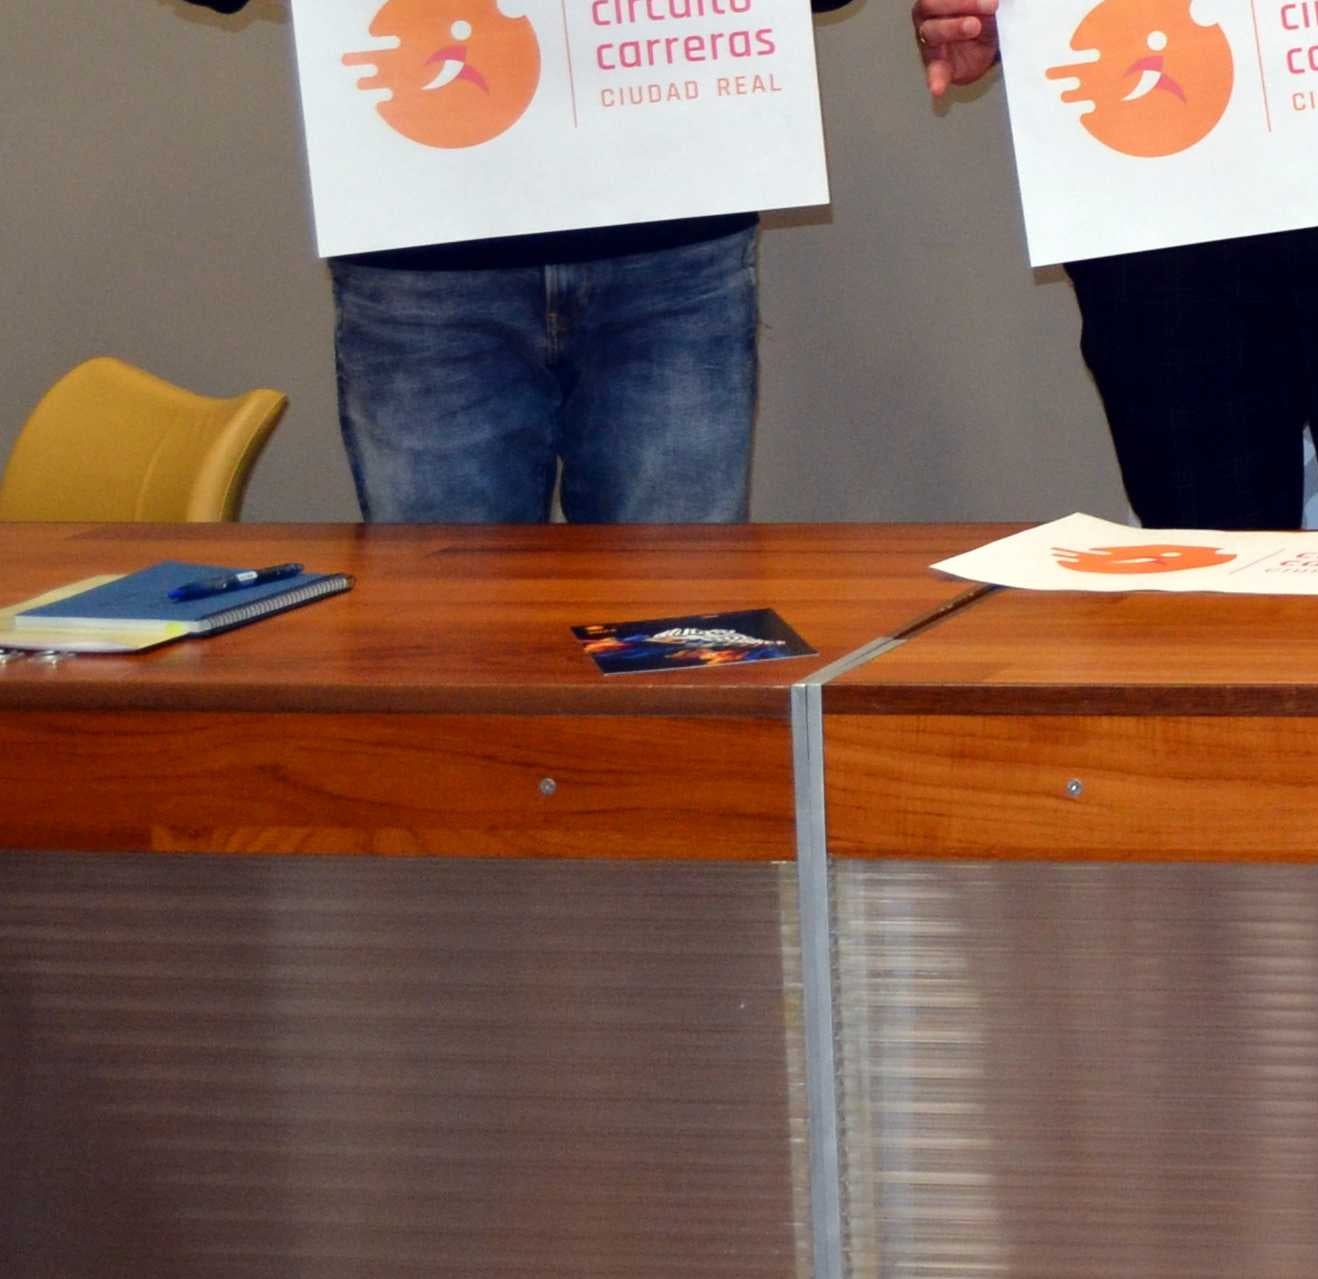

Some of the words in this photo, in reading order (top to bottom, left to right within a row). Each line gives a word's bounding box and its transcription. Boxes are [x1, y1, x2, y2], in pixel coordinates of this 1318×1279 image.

[595, 25, 777, 71] carreras
[600, 80, 699, 108] CIUDAD
[716, 73, 783, 97] REAL
